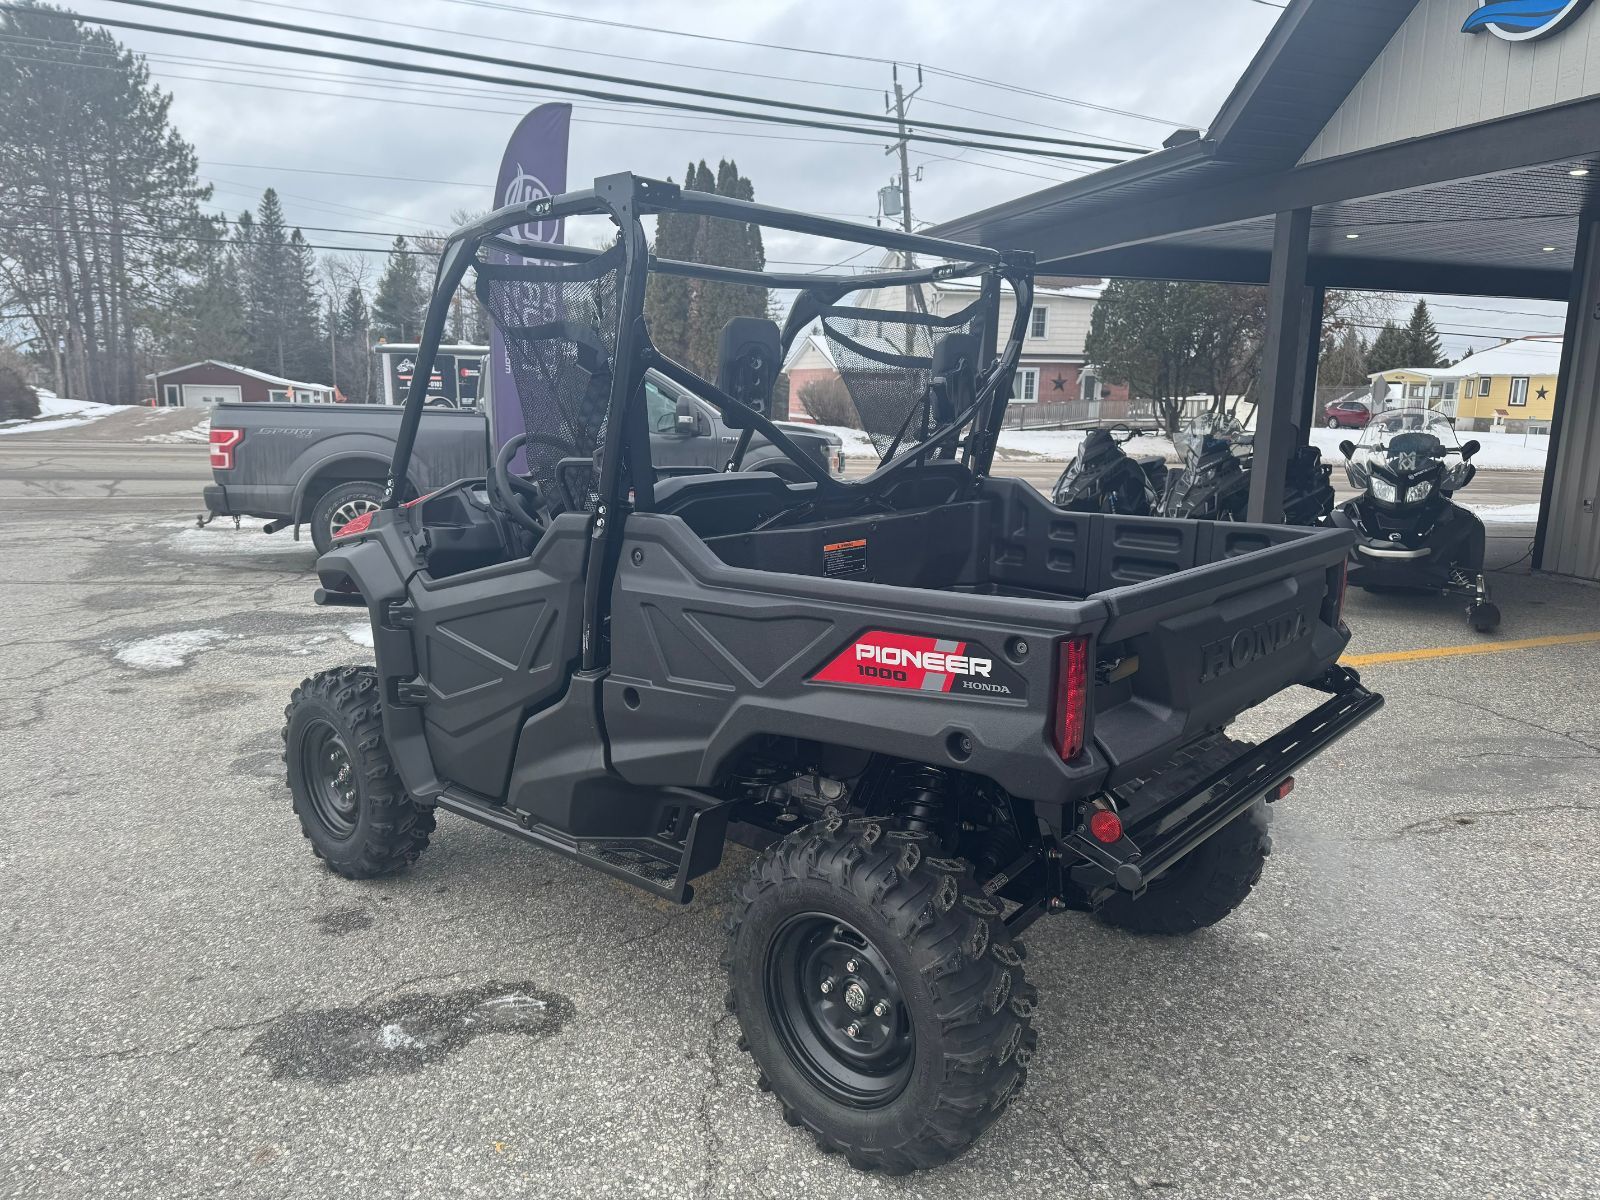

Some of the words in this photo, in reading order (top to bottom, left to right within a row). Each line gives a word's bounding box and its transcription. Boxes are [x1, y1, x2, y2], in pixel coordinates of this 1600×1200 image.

[256, 427, 320, 435] SPORT
[1199, 605, 1312, 684] HONDA
[855, 643, 993, 678] PIONEER
[857, 664, 907, 682] 1000
[962, 680, 1012, 694] HONDA
